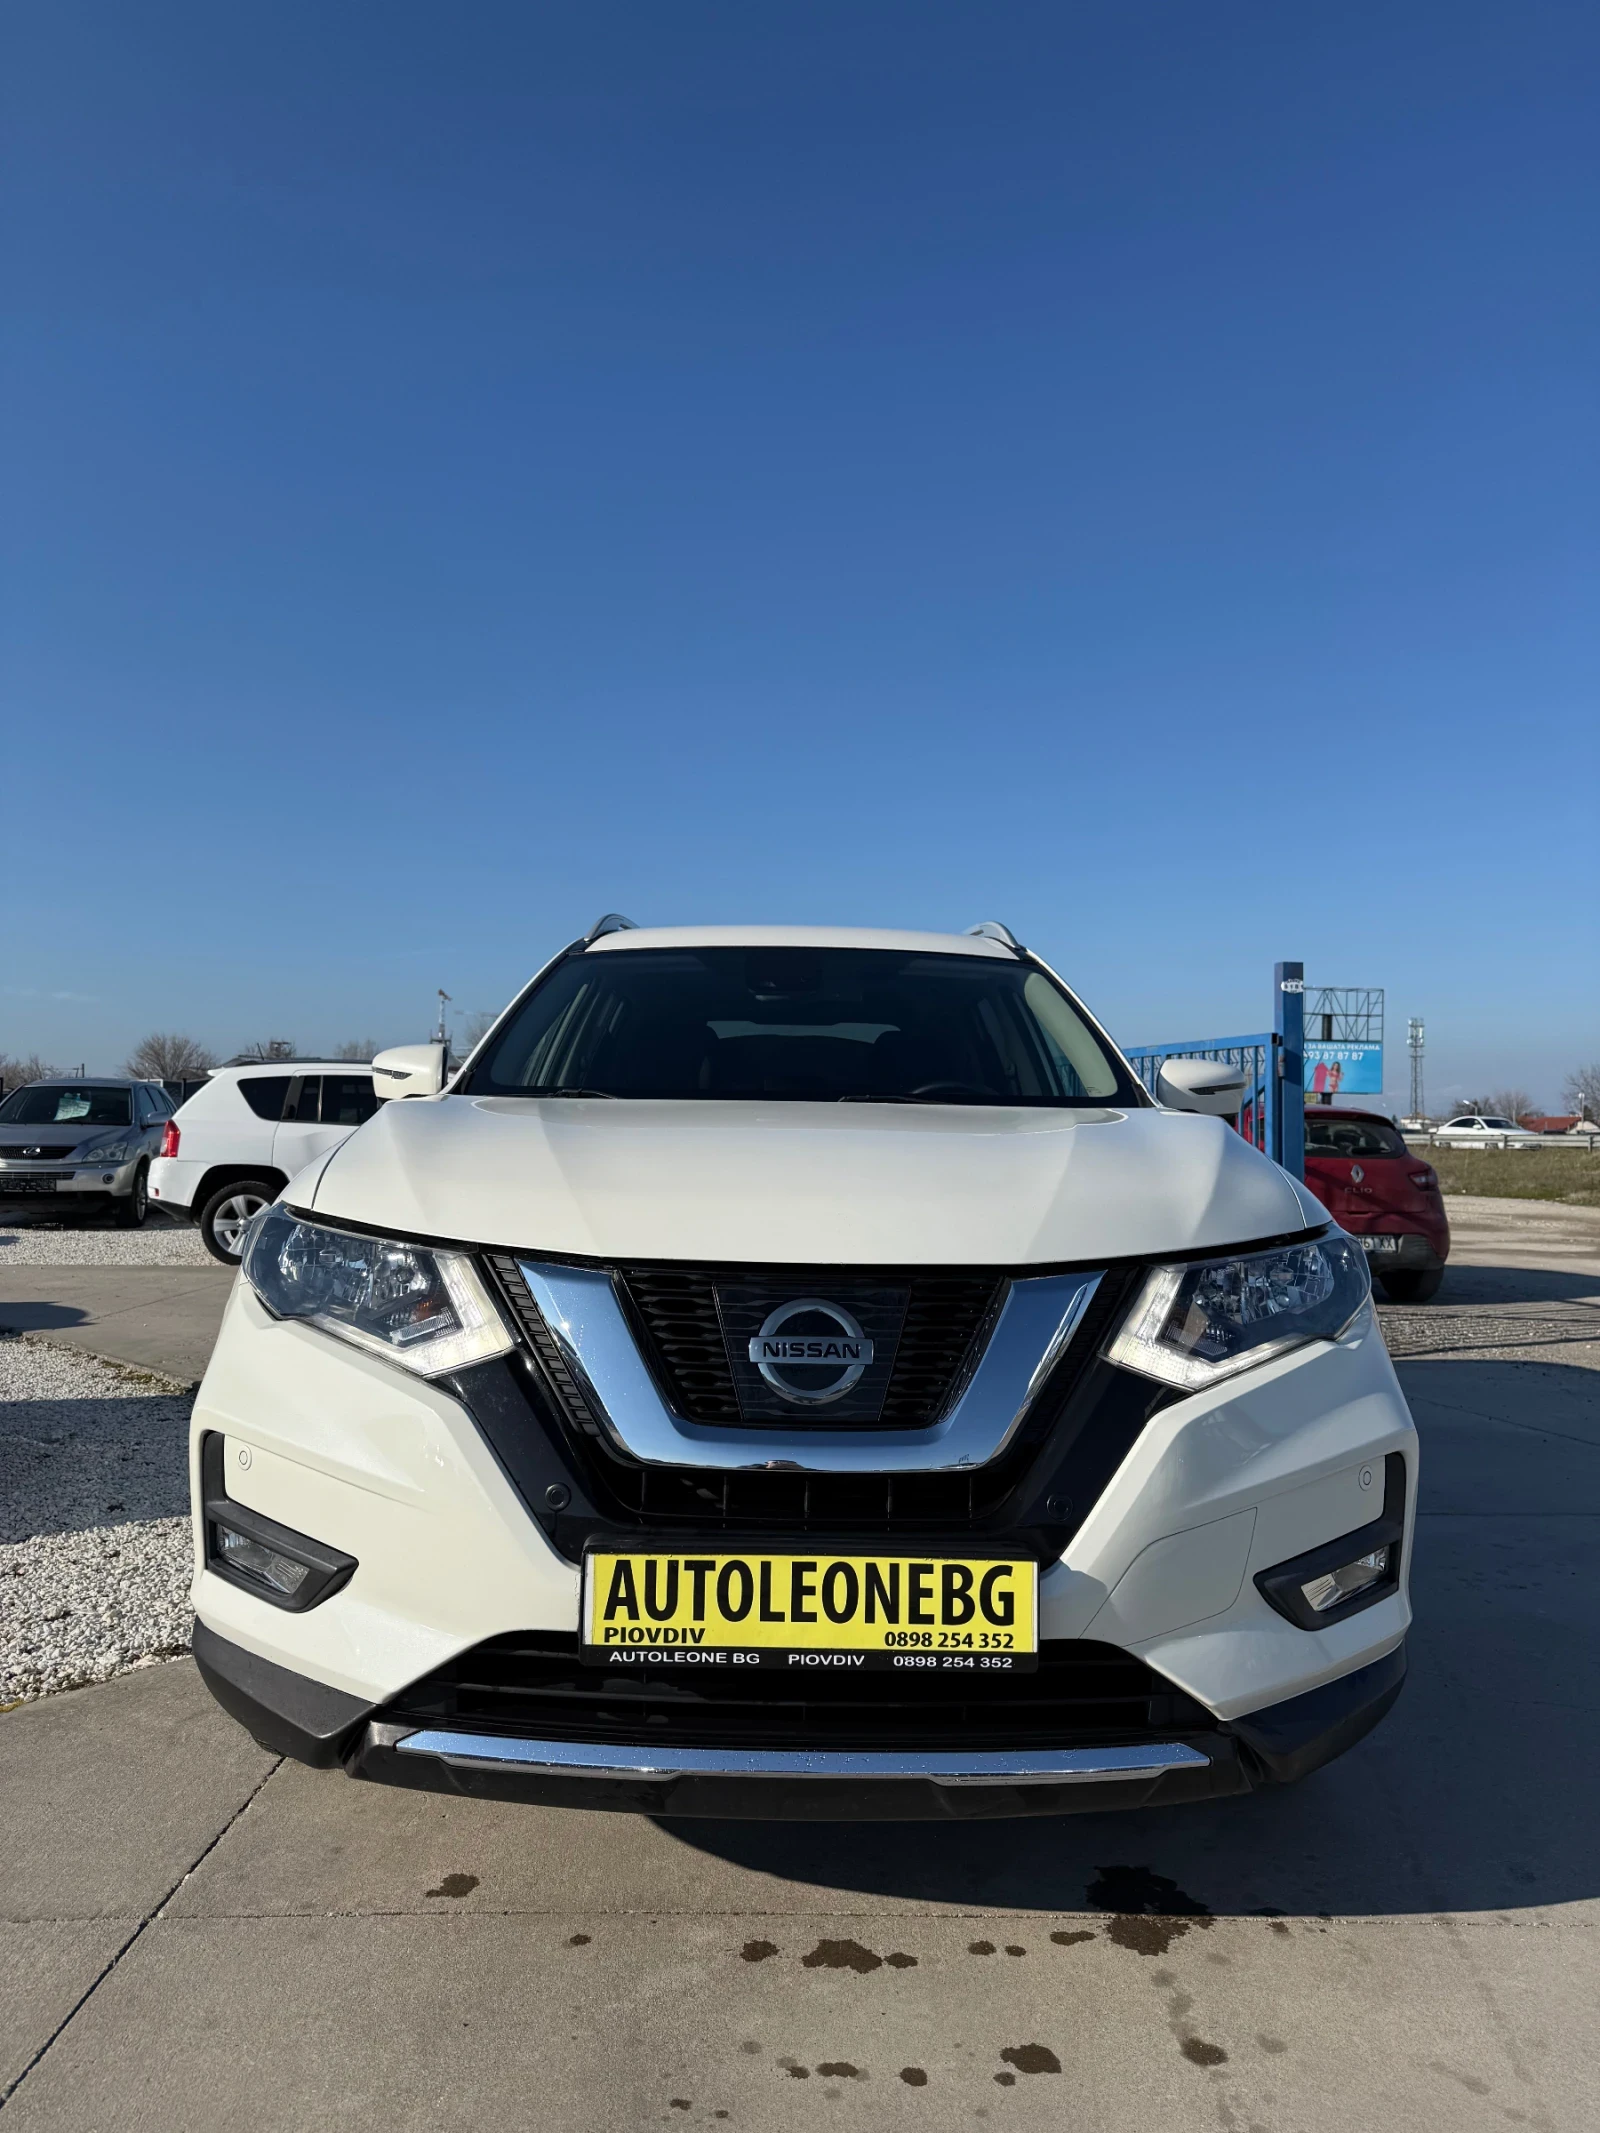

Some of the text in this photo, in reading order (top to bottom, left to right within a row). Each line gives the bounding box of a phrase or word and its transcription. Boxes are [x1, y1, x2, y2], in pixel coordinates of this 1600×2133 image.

[1322, 1051, 1335, 1060] 87
[1337, 1052, 1349, 1060] 87
[1351, 1052, 1364, 1061] 87
[1344, 1186, 1373, 1194] CLIO
[763, 1342, 860, 1359] NISSAN
[603, 1559, 1015, 1627] AUTOLEONEBG
[604, 1627, 1014, 1649] PIOVDIV 0898 254 352
[609, 1651, 1012, 1668] AUTOLEONE BG PIOVDIV 0898 254 352
